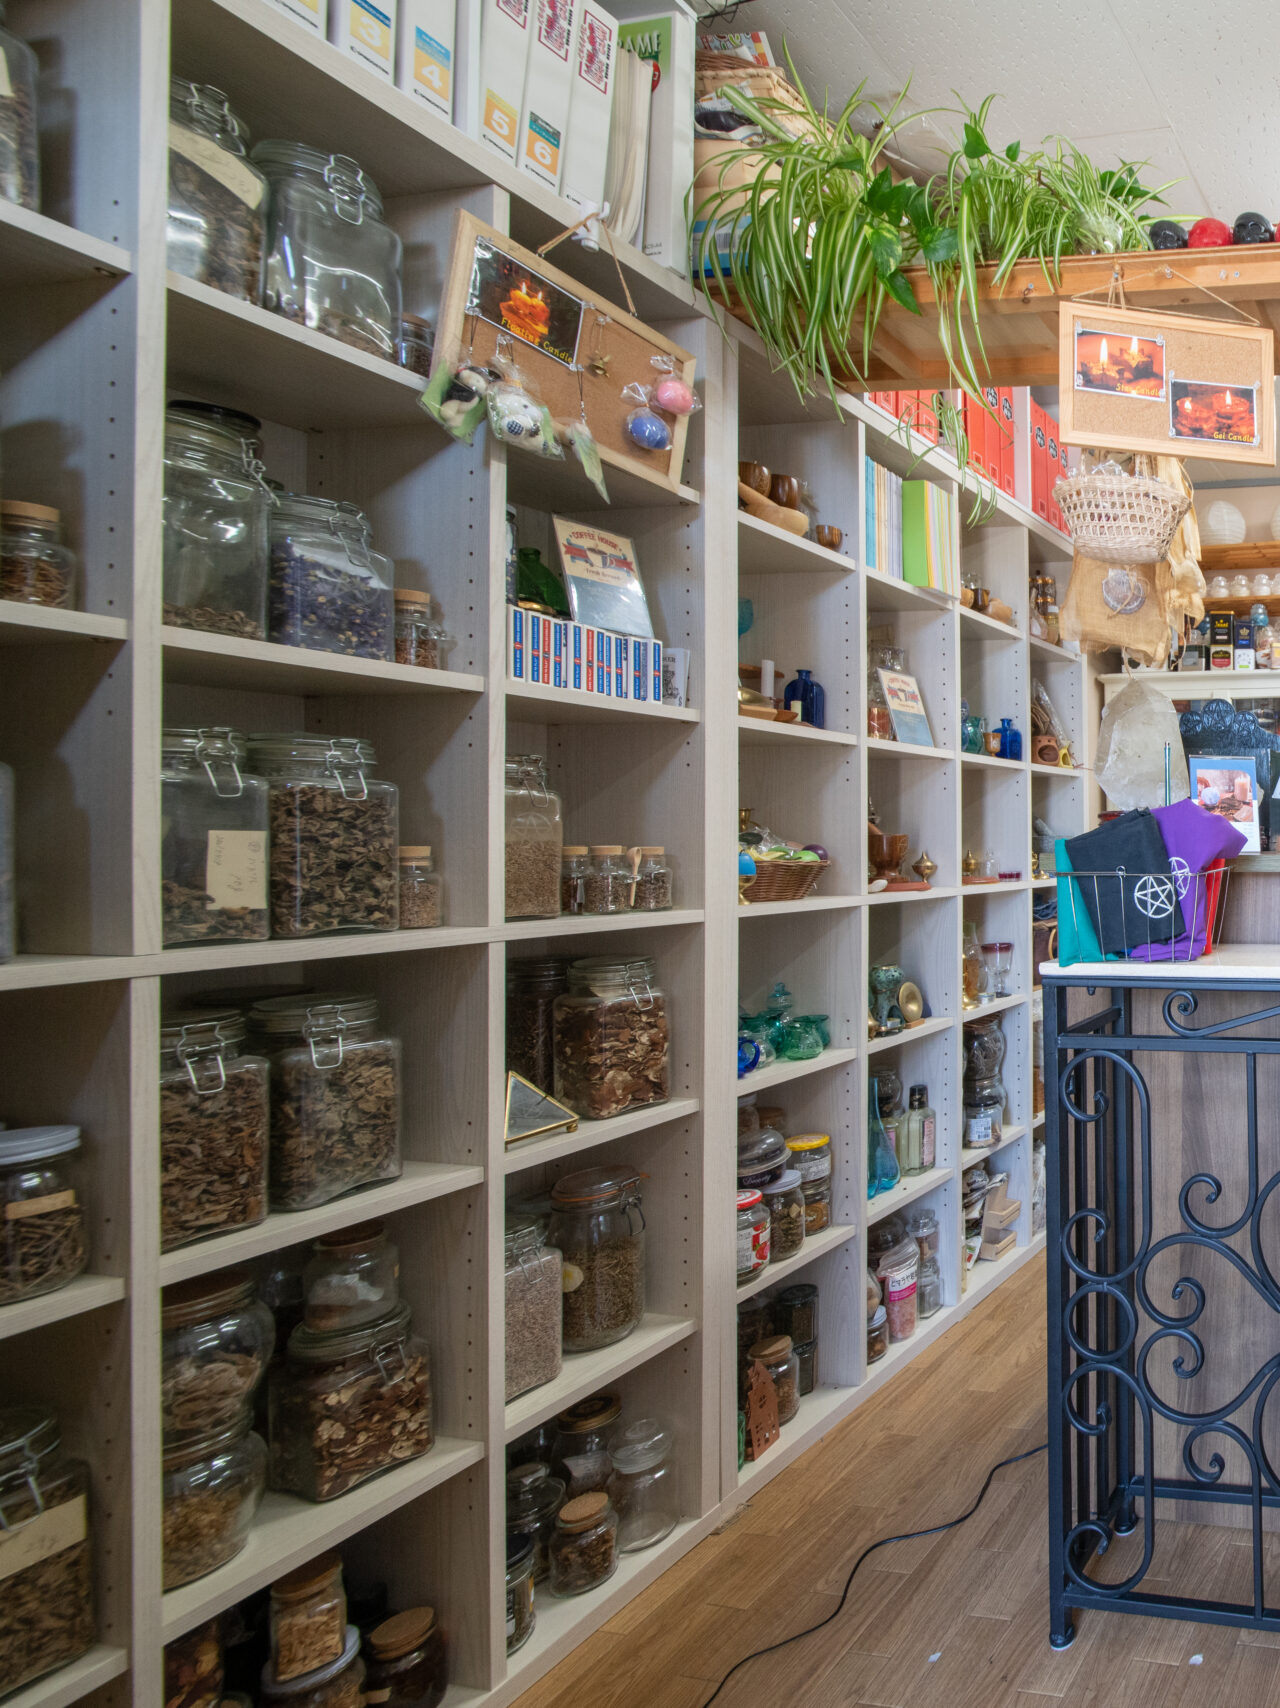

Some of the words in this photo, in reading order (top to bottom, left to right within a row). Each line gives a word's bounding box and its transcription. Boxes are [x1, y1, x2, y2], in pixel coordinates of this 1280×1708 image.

[358, 16, 382, 47] 3
[422, 64, 443, 89] 4
[490, 109, 510, 136] 5
[534, 141, 552, 166] 6
[501, 317, 540, 346] Floating
[543, 341, 573, 364] Candle
